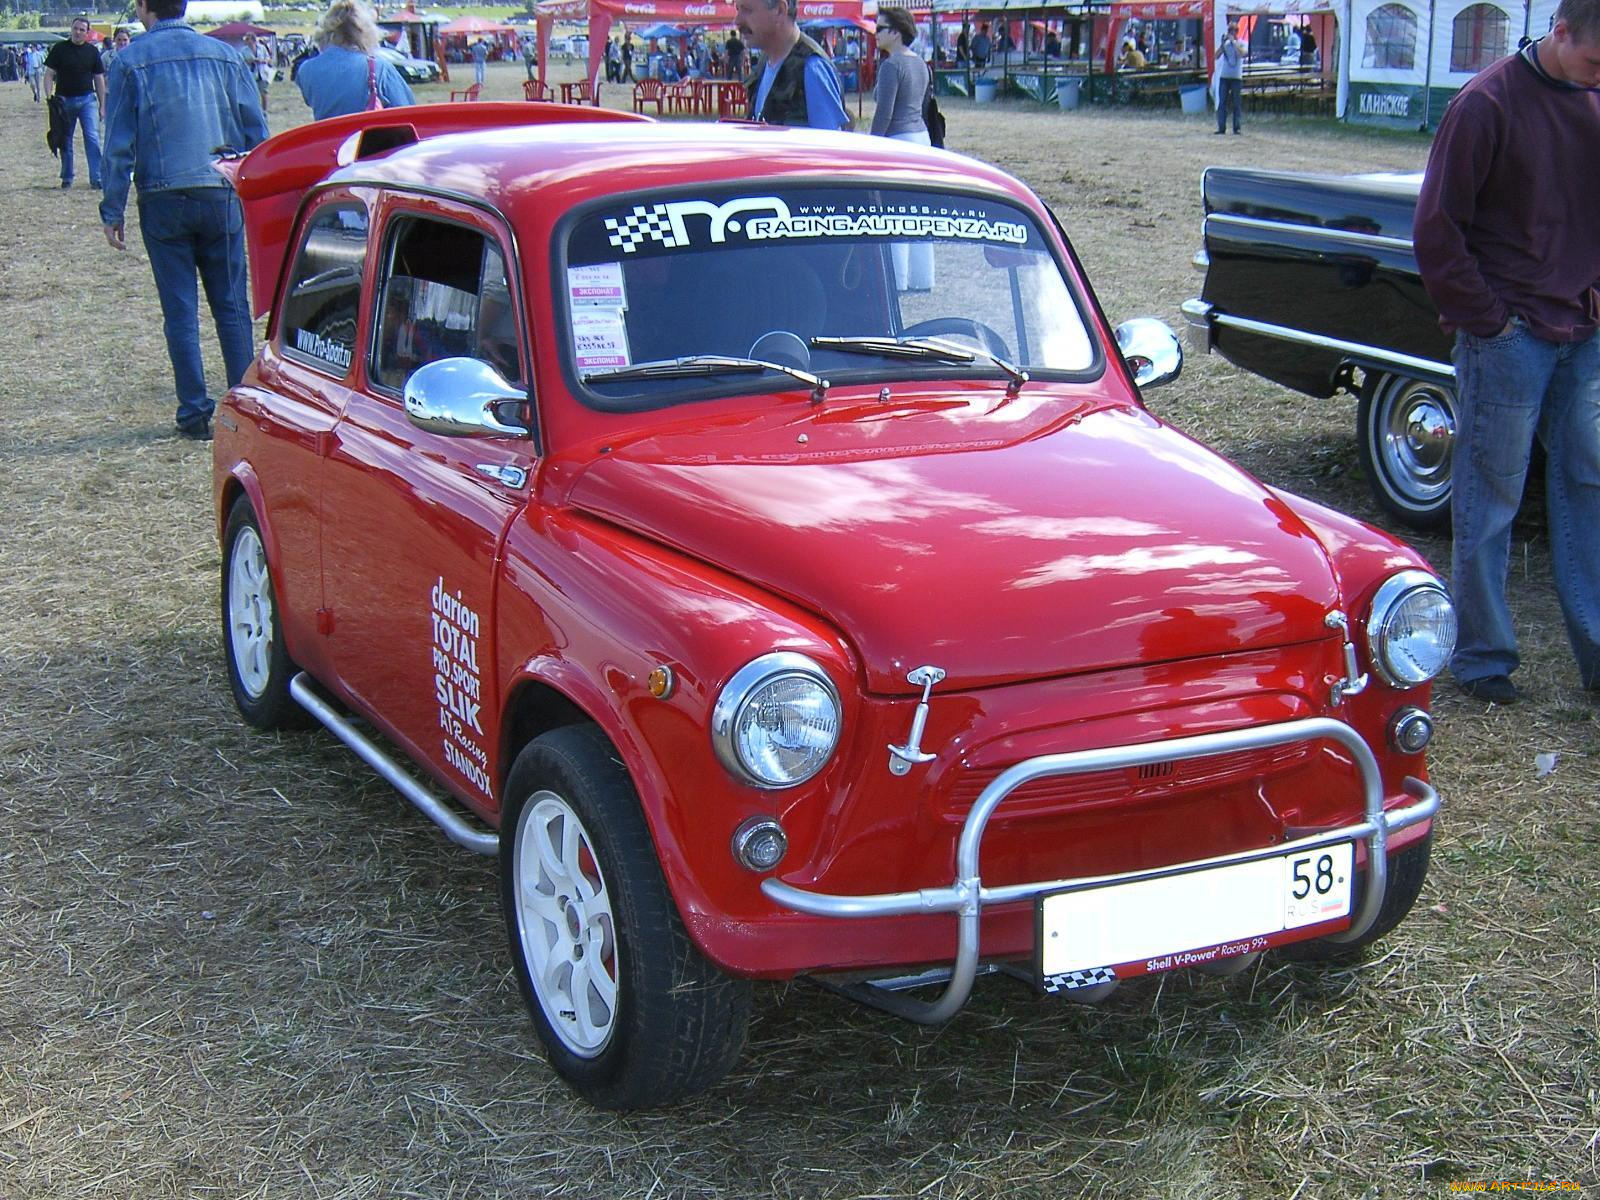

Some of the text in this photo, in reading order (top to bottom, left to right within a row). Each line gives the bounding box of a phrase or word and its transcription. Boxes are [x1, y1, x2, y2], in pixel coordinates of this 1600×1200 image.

[1360, 94, 1409, 117] КЛИНСКОЕ
[750, 216, 1027, 241] RACING.AUTOPENZA.RU
[578, 287, 615, 297] ЭКСПОНАТ
[583, 356, 619, 366] ЭКСПОНАТ
[432, 575, 479, 639] clarion
[431, 611, 480, 675] TOTAL
[435, 673, 484, 736] SLIK
[444, 738, 494, 800] STANDOX
[1292, 854, 1333, 900] 58
[1146, 956, 1172, 972] Shell
[1221, 942, 1250, 955] Racing
[1251, 937, 1268, 949] 99+
